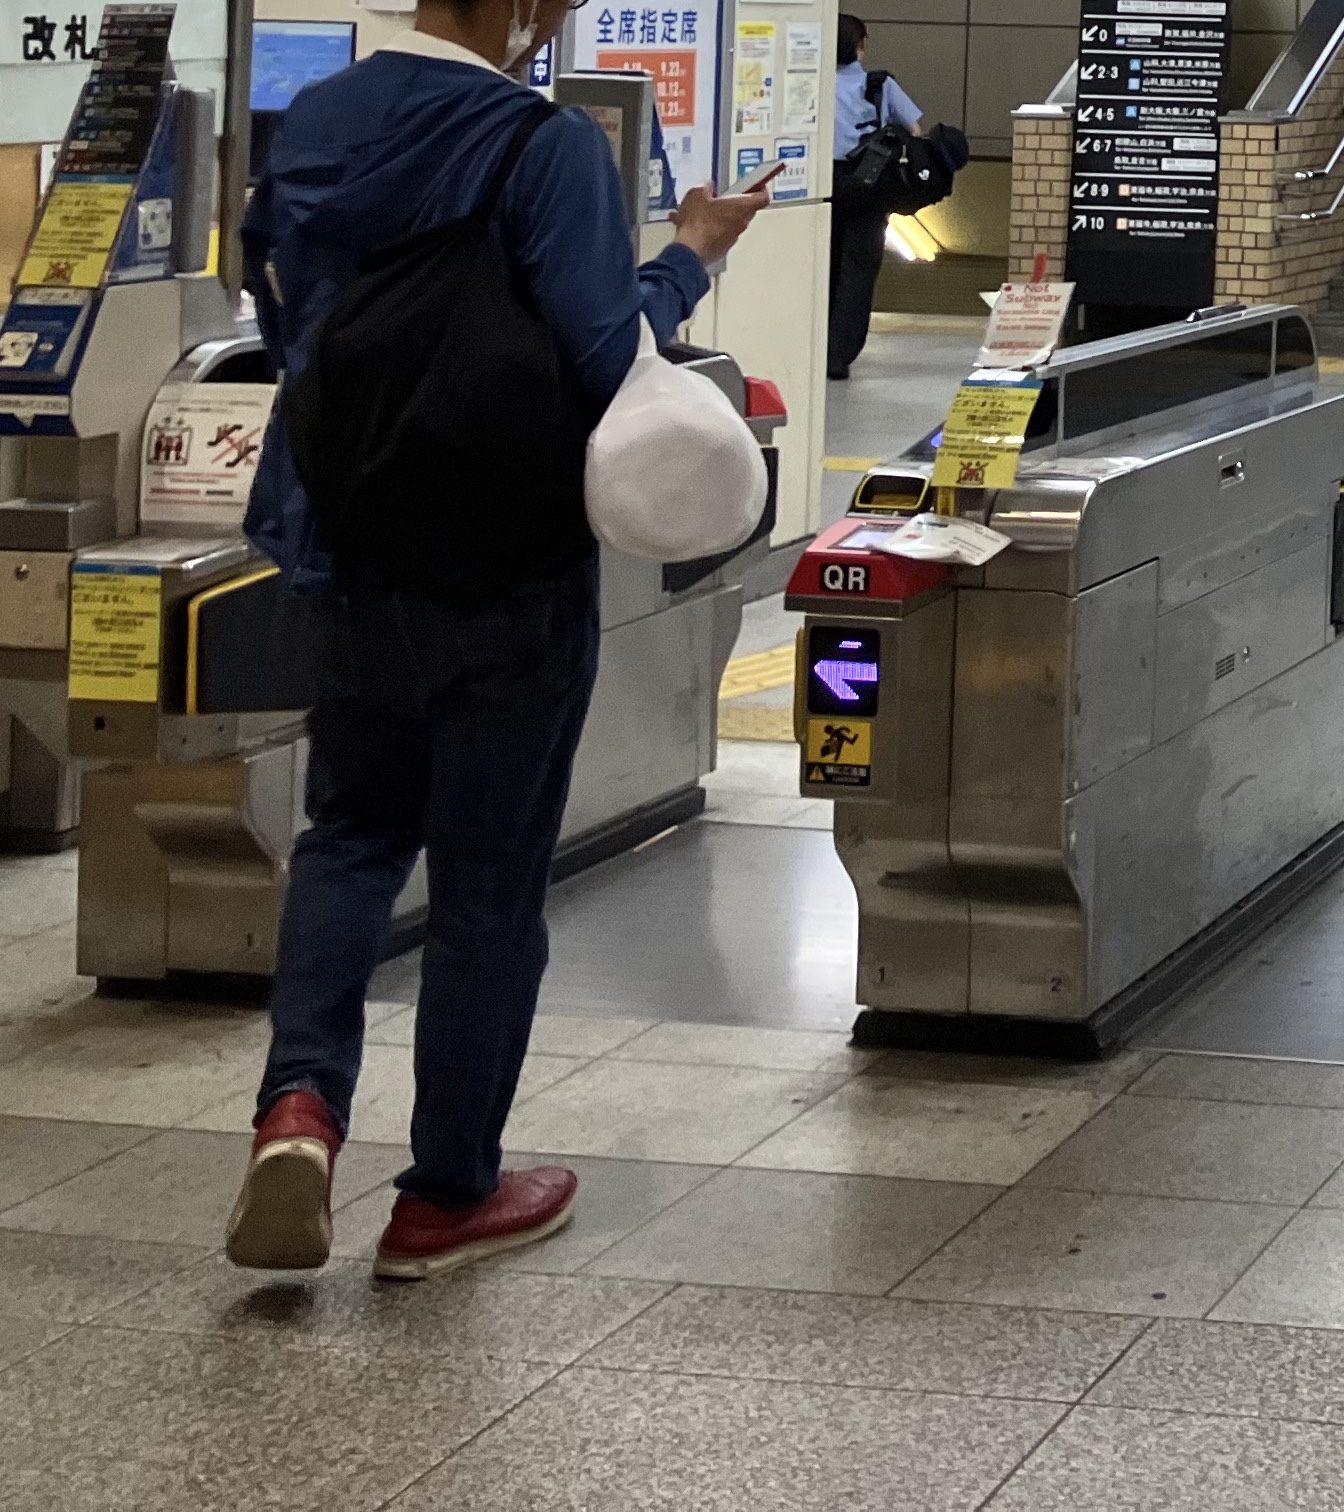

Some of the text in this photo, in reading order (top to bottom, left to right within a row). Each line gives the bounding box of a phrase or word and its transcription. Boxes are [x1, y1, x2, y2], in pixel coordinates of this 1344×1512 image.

[596, 8, 699, 45] 全席指定席
[1099, 28, 1108, 42] 0
[1090, 216, 1105, 230] 10
[1023, 283, 1050, 294] Not
[1004, 292, 1062, 305] Subway
[823, 564, 867, 592] QR
[878, 966, 886, 982] 1
[1050, 976, 1063, 992] 2
